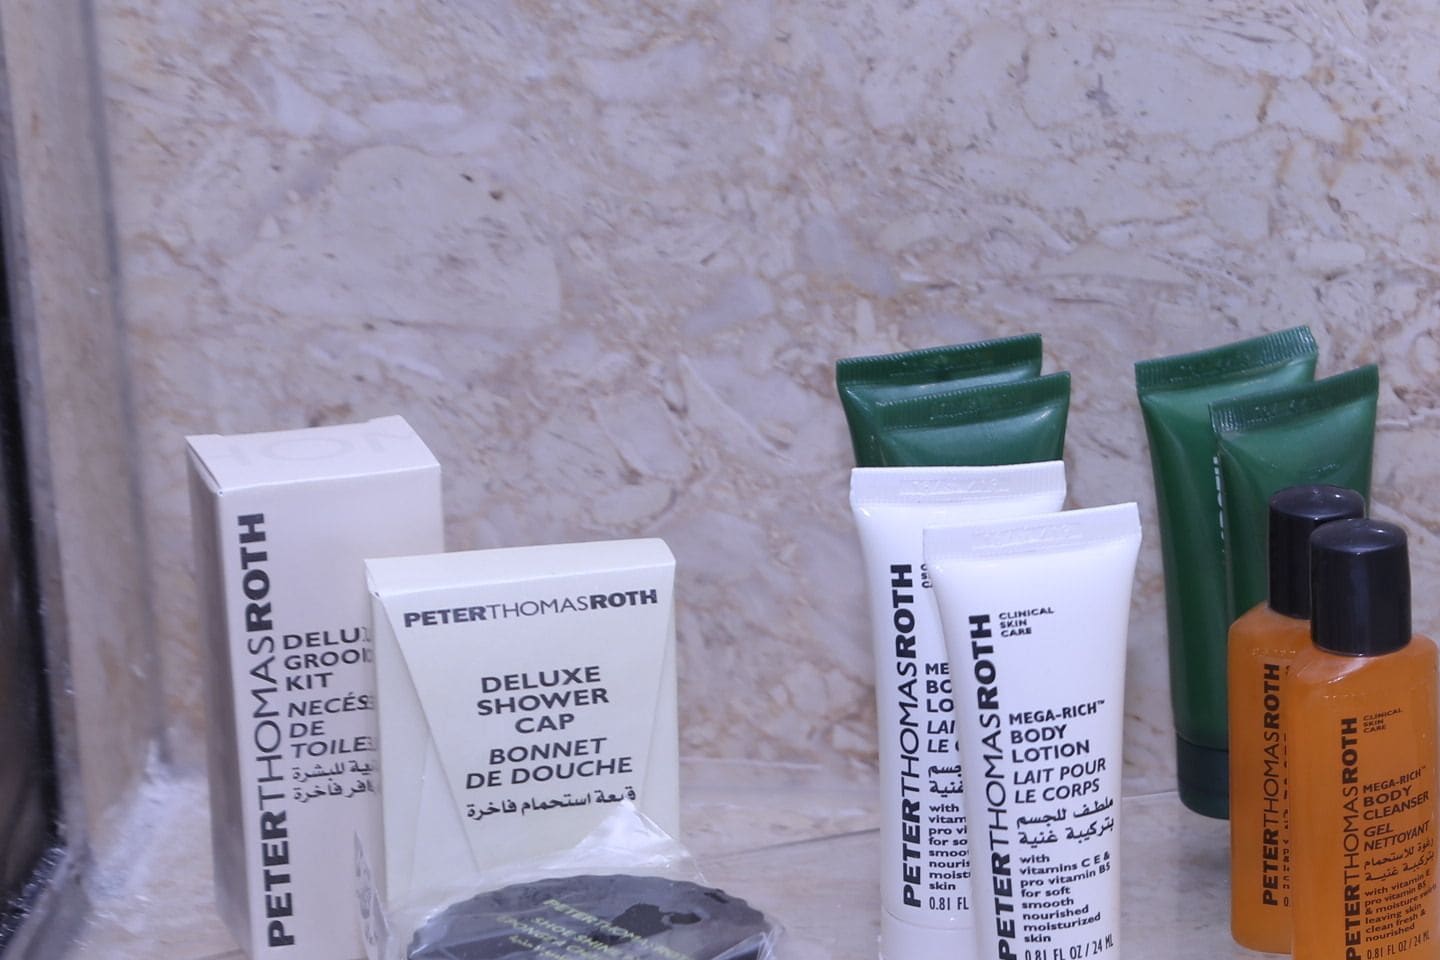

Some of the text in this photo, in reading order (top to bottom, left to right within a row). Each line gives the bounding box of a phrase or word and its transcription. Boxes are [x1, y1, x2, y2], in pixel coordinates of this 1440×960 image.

[403, 589, 659, 627] PETERTHOMASROTH
[998, 607, 1055, 620] CLINICAL
[999, 619, 1027, 629] SKIN
[1000, 627, 1032, 637] CARE
[282, 626, 368, 650] DELU
[285, 672, 333, 691] KIT
[480, 665, 601, 694] DELUXE
[476, 687, 610, 716] SHOWER
[514, 713, 575, 734] CAP
[1362, 708, 1404, 720] CLINICAL
[1363, 719, 1384, 727] SKIN
[237, 513, 295, 947] PETERTHOMASROTH
[289, 720, 325, 738] DE
[889, 563, 921, 908] PETERTHOMASROTH
[1010, 723, 1067, 744] BODY
[1363, 725, 1386, 733] CARE
[489, 737, 608, 765] BONNET
[927, 738, 949, 753] LE
[1011, 739, 1090, 763] LOTION
[465, 756, 634, 789] DE DOUCHE
[1013, 757, 1107, 785] LAIT POUR
[1014, 778, 1101, 804] LE CORPS
[1263, 663, 1280, 906] PETERTHOMASROTH
[521, 792, 591, 816] استحمام
[1363, 785, 1412, 807] BODY
[1363, 790, 1430, 821] CLEANSER
[466, 798, 517, 821] فاخرة
[928, 803, 959, 812] with
[1016, 807, 1067, 829] للجسم
[929, 827, 952, 837] pro
[1018, 830, 1058, 848] غنية
[1363, 823, 1393, 837] GEL
[1363, 820, 1430, 852] NETTOYANT
[928, 836, 949, 846] for
[929, 849, 969, 857] smoo
[1019, 853, 1050, 864] with
[1019, 851, 1110, 875] vitamins C E &
[1020, 861, 1111, 888] pro vitamin B5
[1365, 886, 1388, 897] with
[1391, 873, 1424, 891] vitamin
[929, 881, 956, 890] skin
[1021, 886, 1071, 898] for soft
[929, 896, 969, 911] 0.81 FL
[1022, 897, 1074, 909] smooth
[1365, 898, 1382, 908] pro
[1384, 887, 1416, 902] vitamin
[1365, 895, 1418, 915] & moisture
[1022, 904, 1089, 920] nourished
[1023, 912, 1101, 931] moisturized
[1365, 911, 1402, 925] leaving
[1366, 923, 1393, 934] clean
[1396, 913, 1418, 926] fresh
[1366, 922, 1415, 942] nourished
[1024, 933, 1051, 943] skin
[1069, 945, 1083, 960] OZ
[1092, 938, 1102, 955] 24
[1105, 933, 1114, 949] ML
[1367, 947, 1383, 960] 0.81
[1387, 944, 1396, 956] FL
[1398, 940, 1407, 952] OZ
[1414, 933, 1421, 947] 24
